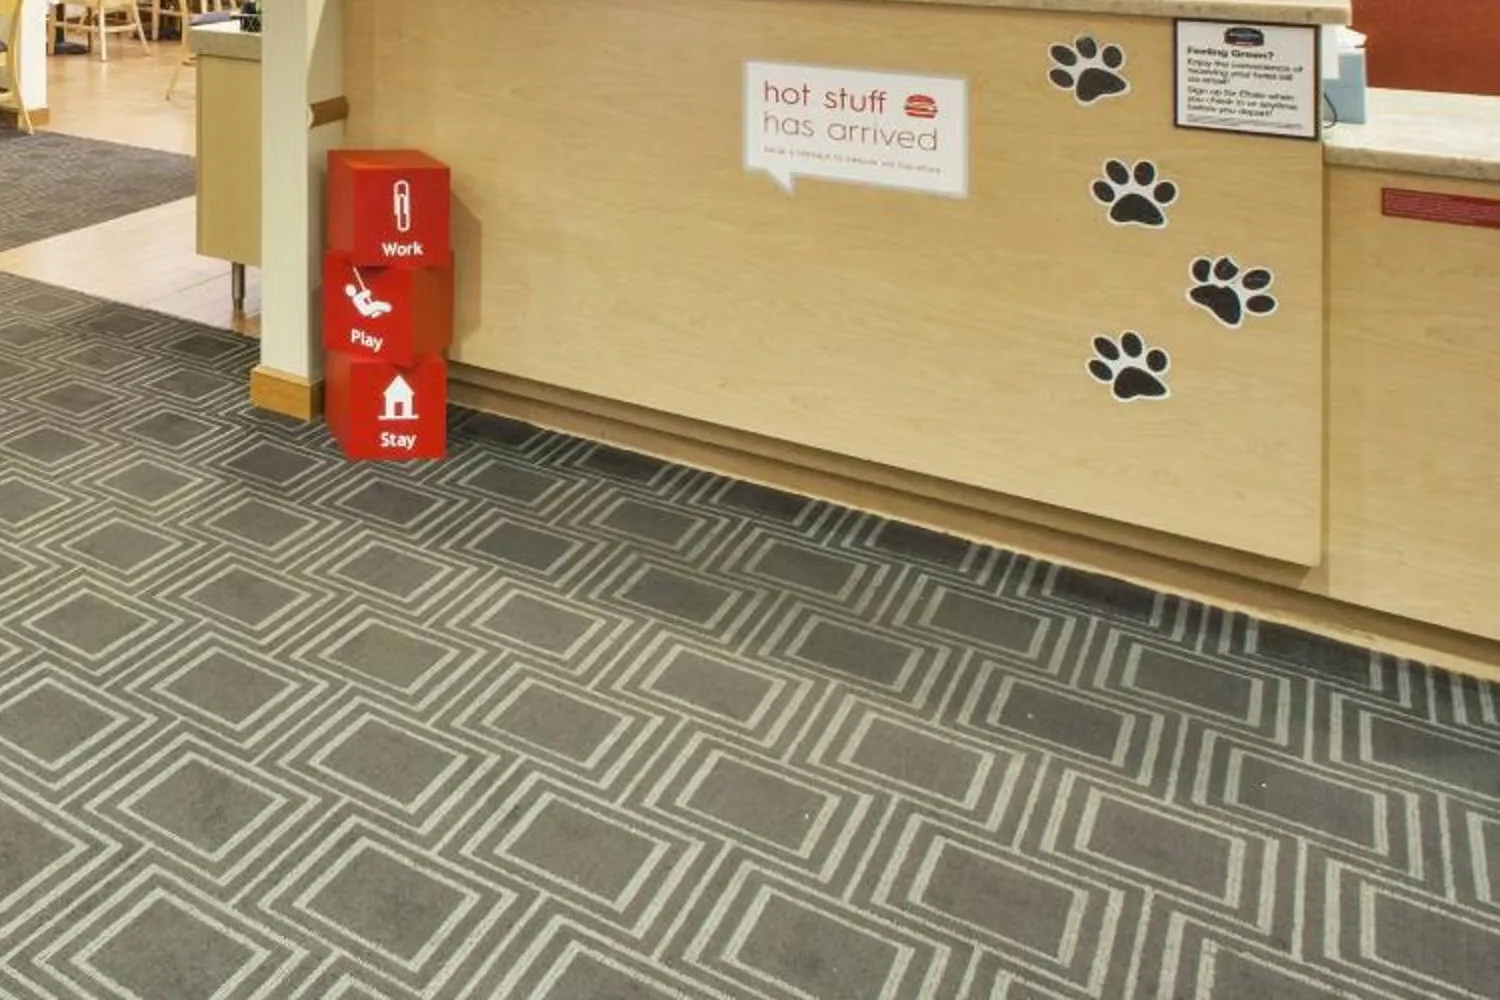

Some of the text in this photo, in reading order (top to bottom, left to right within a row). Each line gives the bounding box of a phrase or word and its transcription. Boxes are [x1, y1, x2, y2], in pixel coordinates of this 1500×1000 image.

[1187, 46, 1274, 60] Feeling Green?
[763, 80, 887, 115] hot stuff
[762, 110, 938, 152] has arrived
[381, 242, 424, 257] Work
[350, 329, 383, 352] Play
[379, 431, 417, 450] Stay
